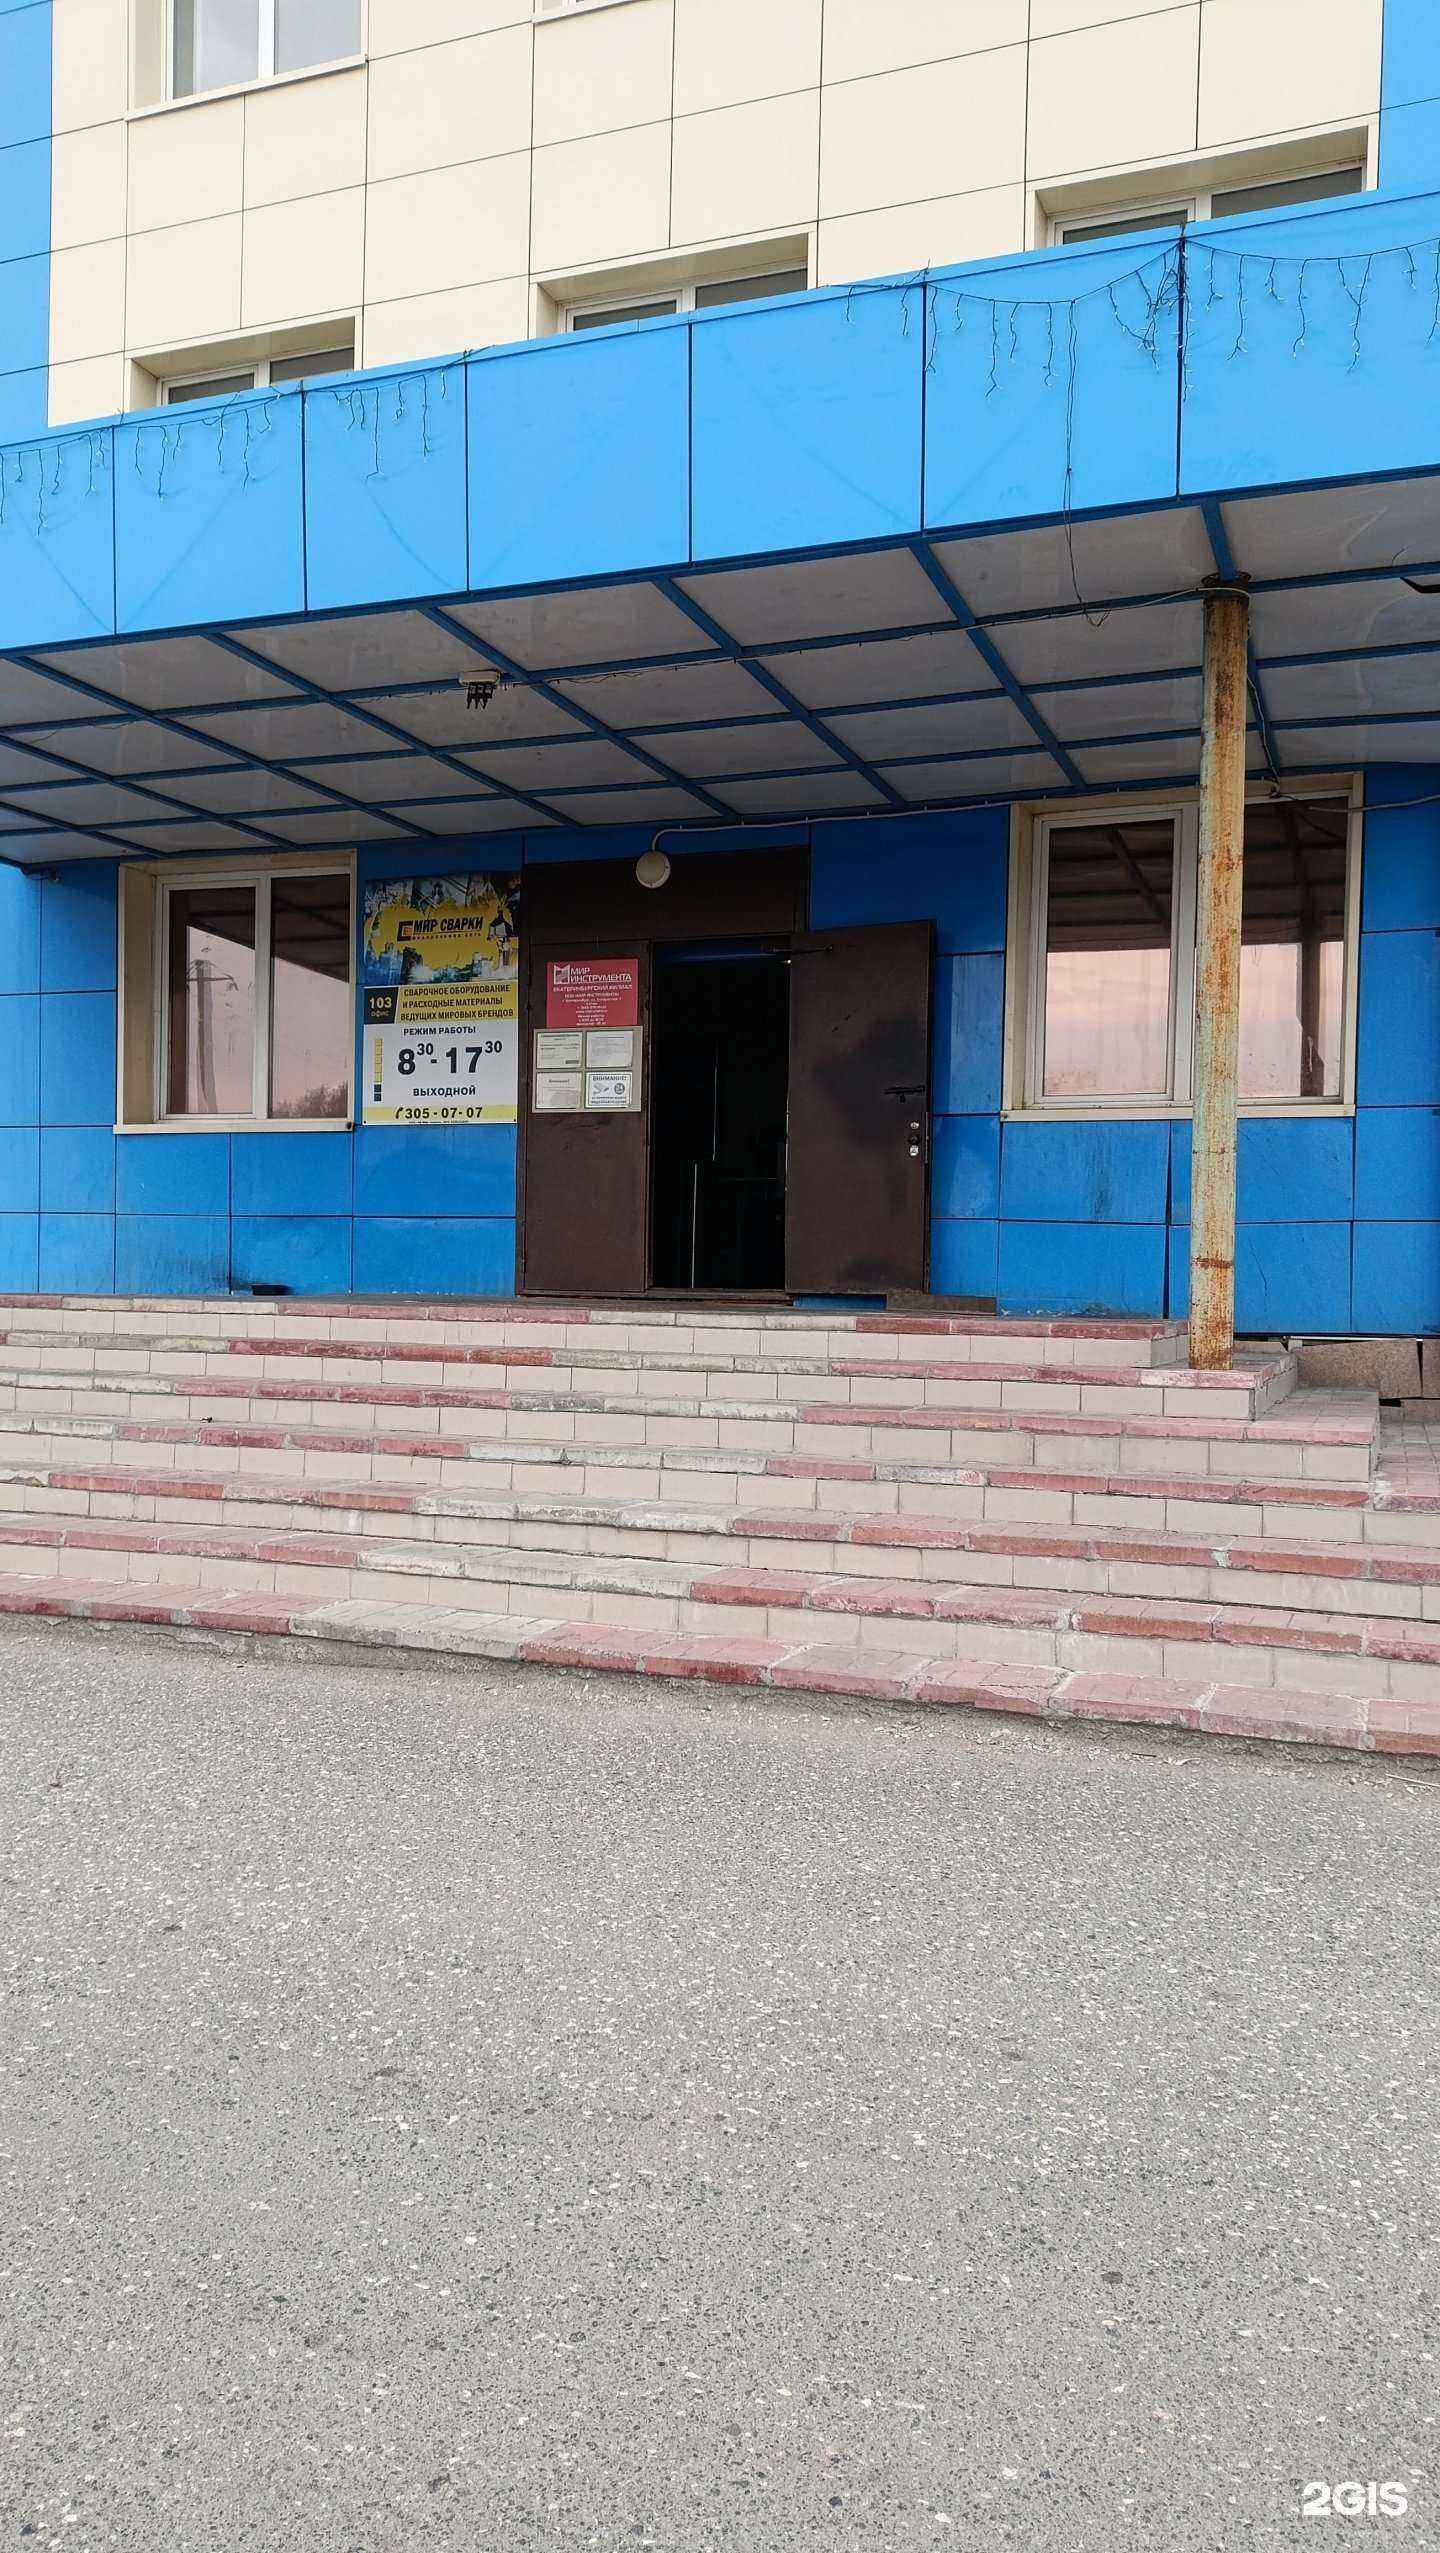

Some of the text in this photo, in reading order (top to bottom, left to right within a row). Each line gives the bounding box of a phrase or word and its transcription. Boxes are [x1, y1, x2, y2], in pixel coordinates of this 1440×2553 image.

[413, 917, 484, 933] МИР СВАРКИ
[570, 967, 590, 975] МИР
[570, 974, 632, 983] ИНСТРУМЕНТА
[404, 984, 511, 997] СВАРОЧНОЕ ОБОРУДОВАНИЕ
[369, 997, 392, 1009] 103
[409, 999, 455, 1009] РАСХОДНЫЕ
[456, 997, 503, 1007] МАТЕРИАЛЫ
[400, 1009, 514, 1022] ВЕДУЩИХ МИРОВЫХ БРЕНДОВ
[403, 1026, 476, 1036] РЕЖИМ РАБОТЫ
[413, 1085, 476, 1098] ВЫХОДНОЙ
